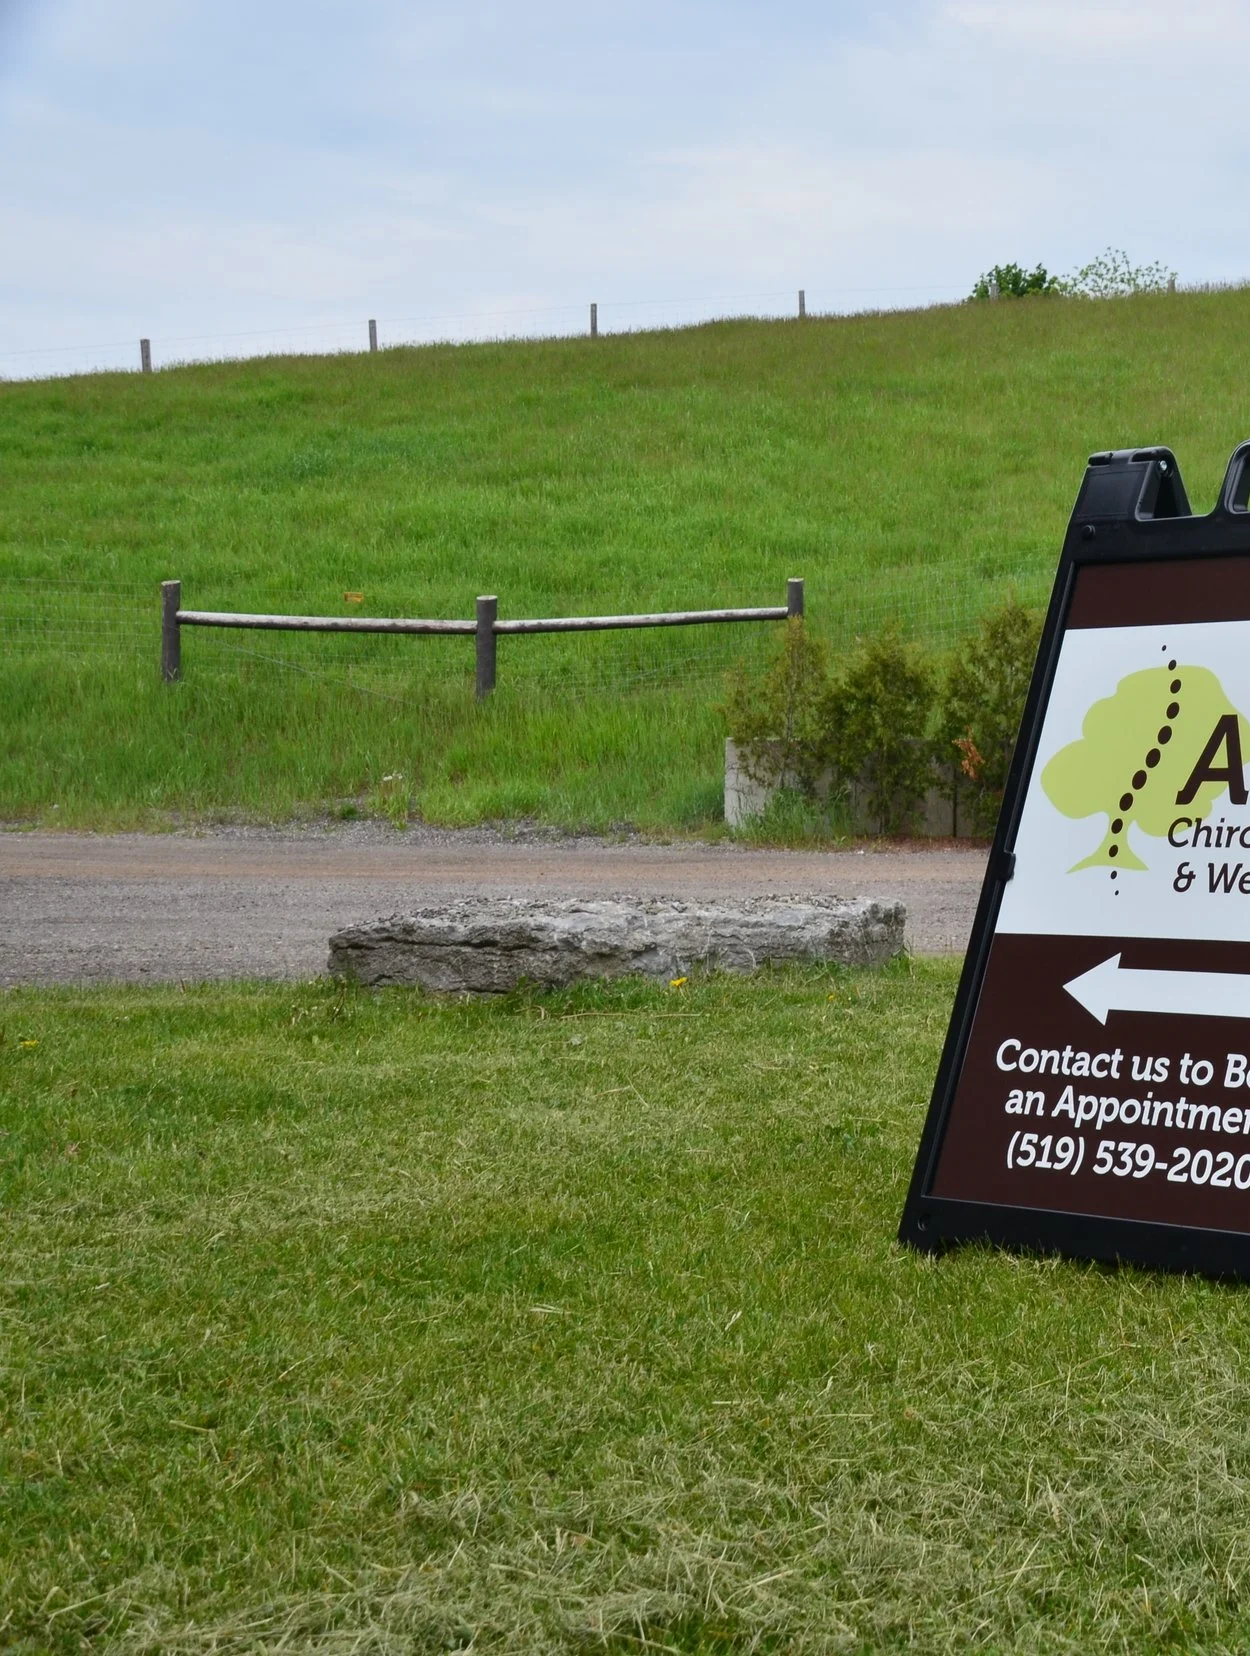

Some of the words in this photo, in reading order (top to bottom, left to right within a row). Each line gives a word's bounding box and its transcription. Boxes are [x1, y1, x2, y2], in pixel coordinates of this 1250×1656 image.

[1172, 861, 1197, 893] &
[996, 1038, 1124, 1080] Contact
[1131, 1055, 1171, 1083] us
[1179, 1052, 1214, 1086] to
[1004, 1089, 1046, 1117] an
[1006, 1130, 1085, 1176] (519)
